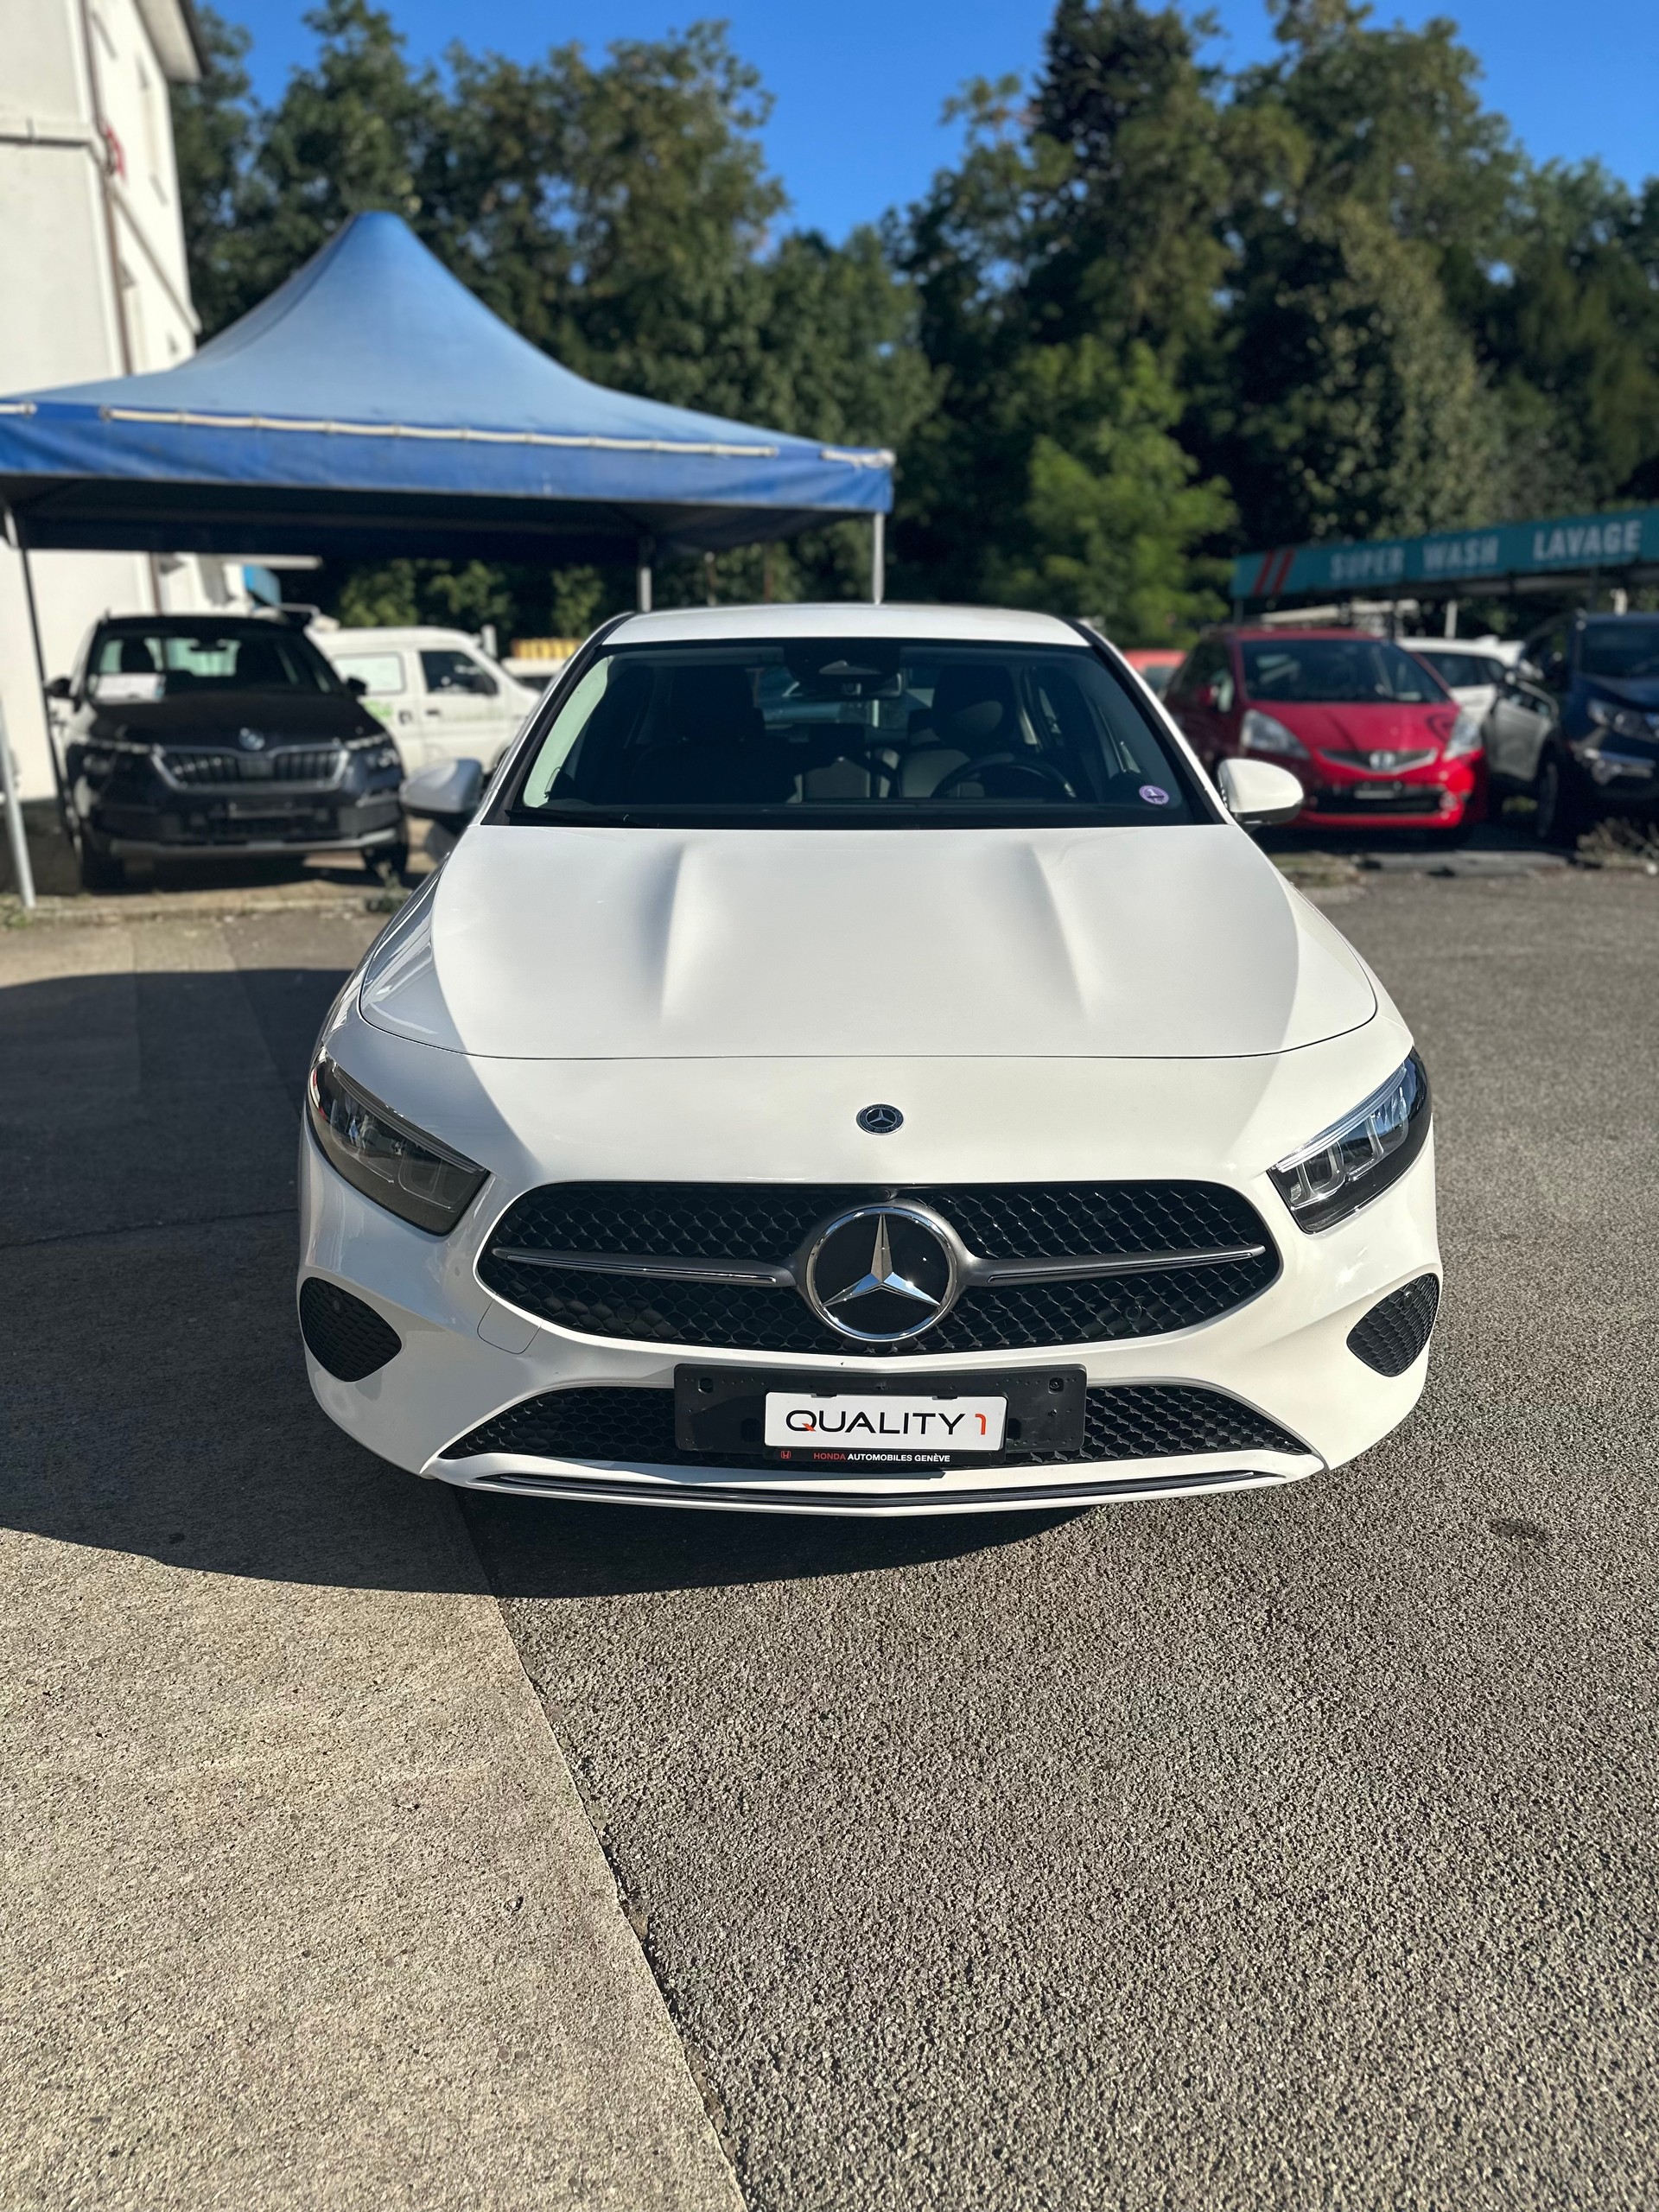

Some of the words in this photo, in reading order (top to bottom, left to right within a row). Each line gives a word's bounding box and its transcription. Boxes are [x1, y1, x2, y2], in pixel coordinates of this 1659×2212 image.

[1424, 537, 1498, 569] WASH
[1533, 520, 1642, 560] LAVAGE
[785, 1409, 966, 1435] QUALITY
[813, 1452, 847, 1461] HONDA
[847, 1452, 913, 1462] AUTOMOBILES
[914, 1452, 950, 1462] GENÈVE
